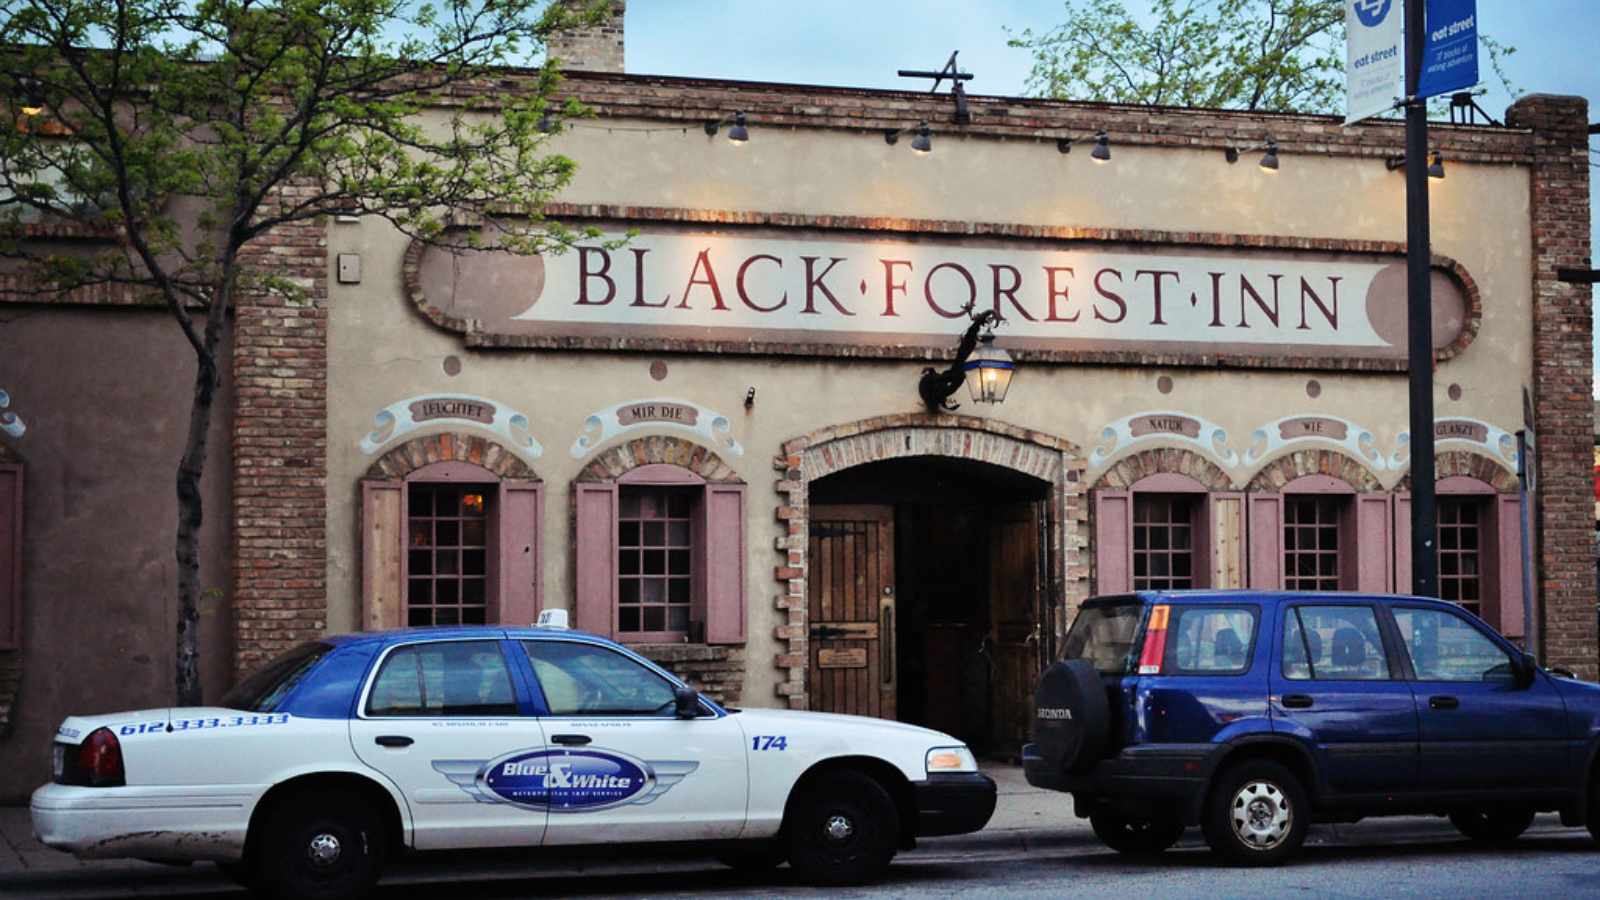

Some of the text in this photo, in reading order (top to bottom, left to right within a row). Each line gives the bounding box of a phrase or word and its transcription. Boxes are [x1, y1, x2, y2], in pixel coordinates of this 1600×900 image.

[1354, 45, 1397, 69] eat street
[574, 247, 1343, 331] BLACK FOREST INN
[631, 406, 683, 419] MIR DIE
[1037, 708, 1072, 719] HONDA
[119, 714, 289, 736] 612333.3333
[752, 735, 787, 751] 174
[502, 762, 632, 789] Blue & White
